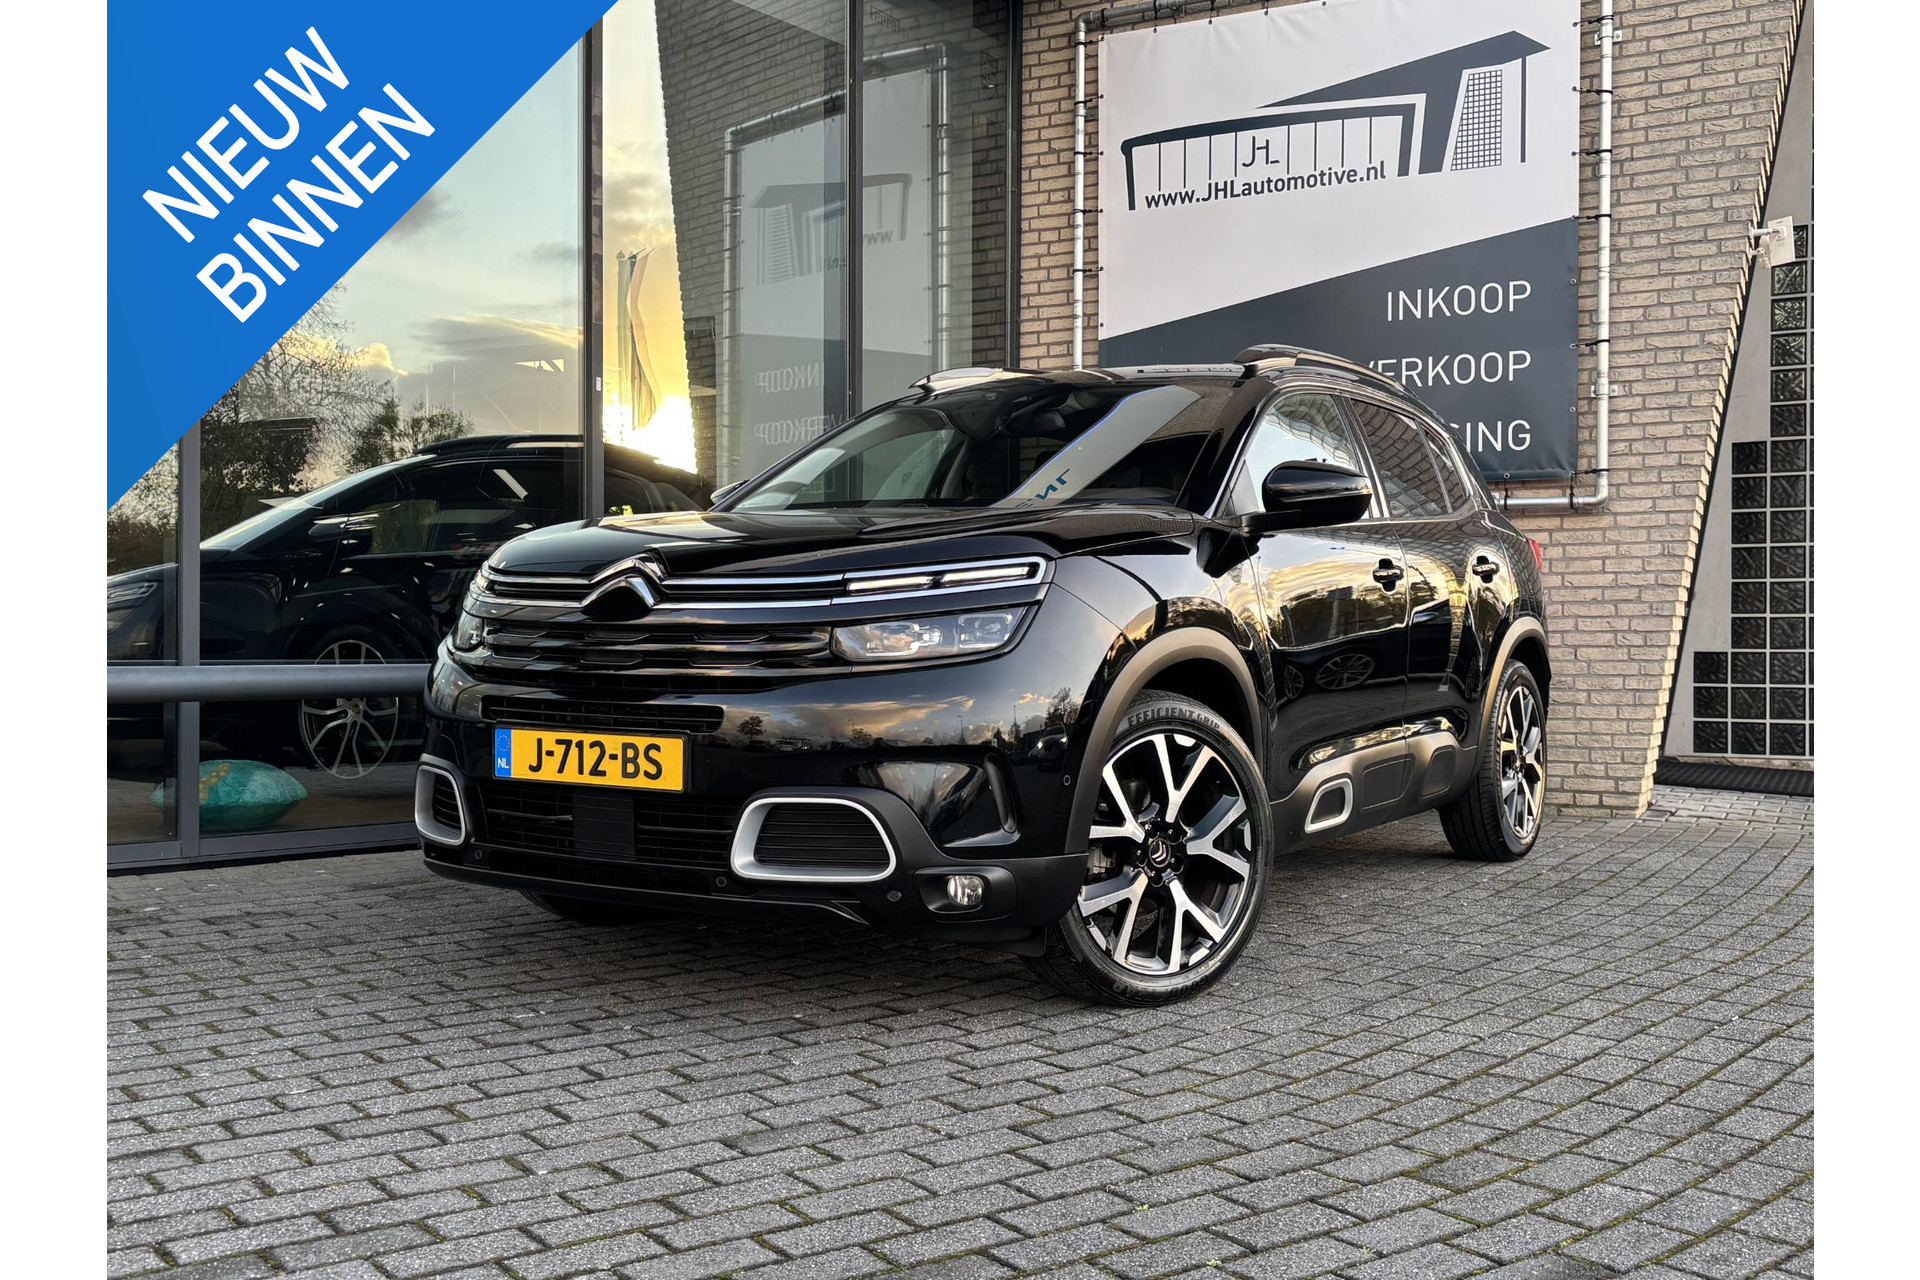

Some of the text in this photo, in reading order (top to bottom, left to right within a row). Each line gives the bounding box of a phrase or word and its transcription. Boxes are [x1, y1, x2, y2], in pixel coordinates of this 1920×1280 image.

[1144, 160, 1387, 209] www.JHLautomotive.nl
[1387, 280, 1532, 322] INKOOP
[1368, 350, 1532, 387] ERKOOP
[1449, 419, 1532, 453] ING
[1127, 706, 1220, 730] EFFICIENT GRIP
[497, 758, 510, 769] NL
[528, 737, 663, 781] J-712-BS
